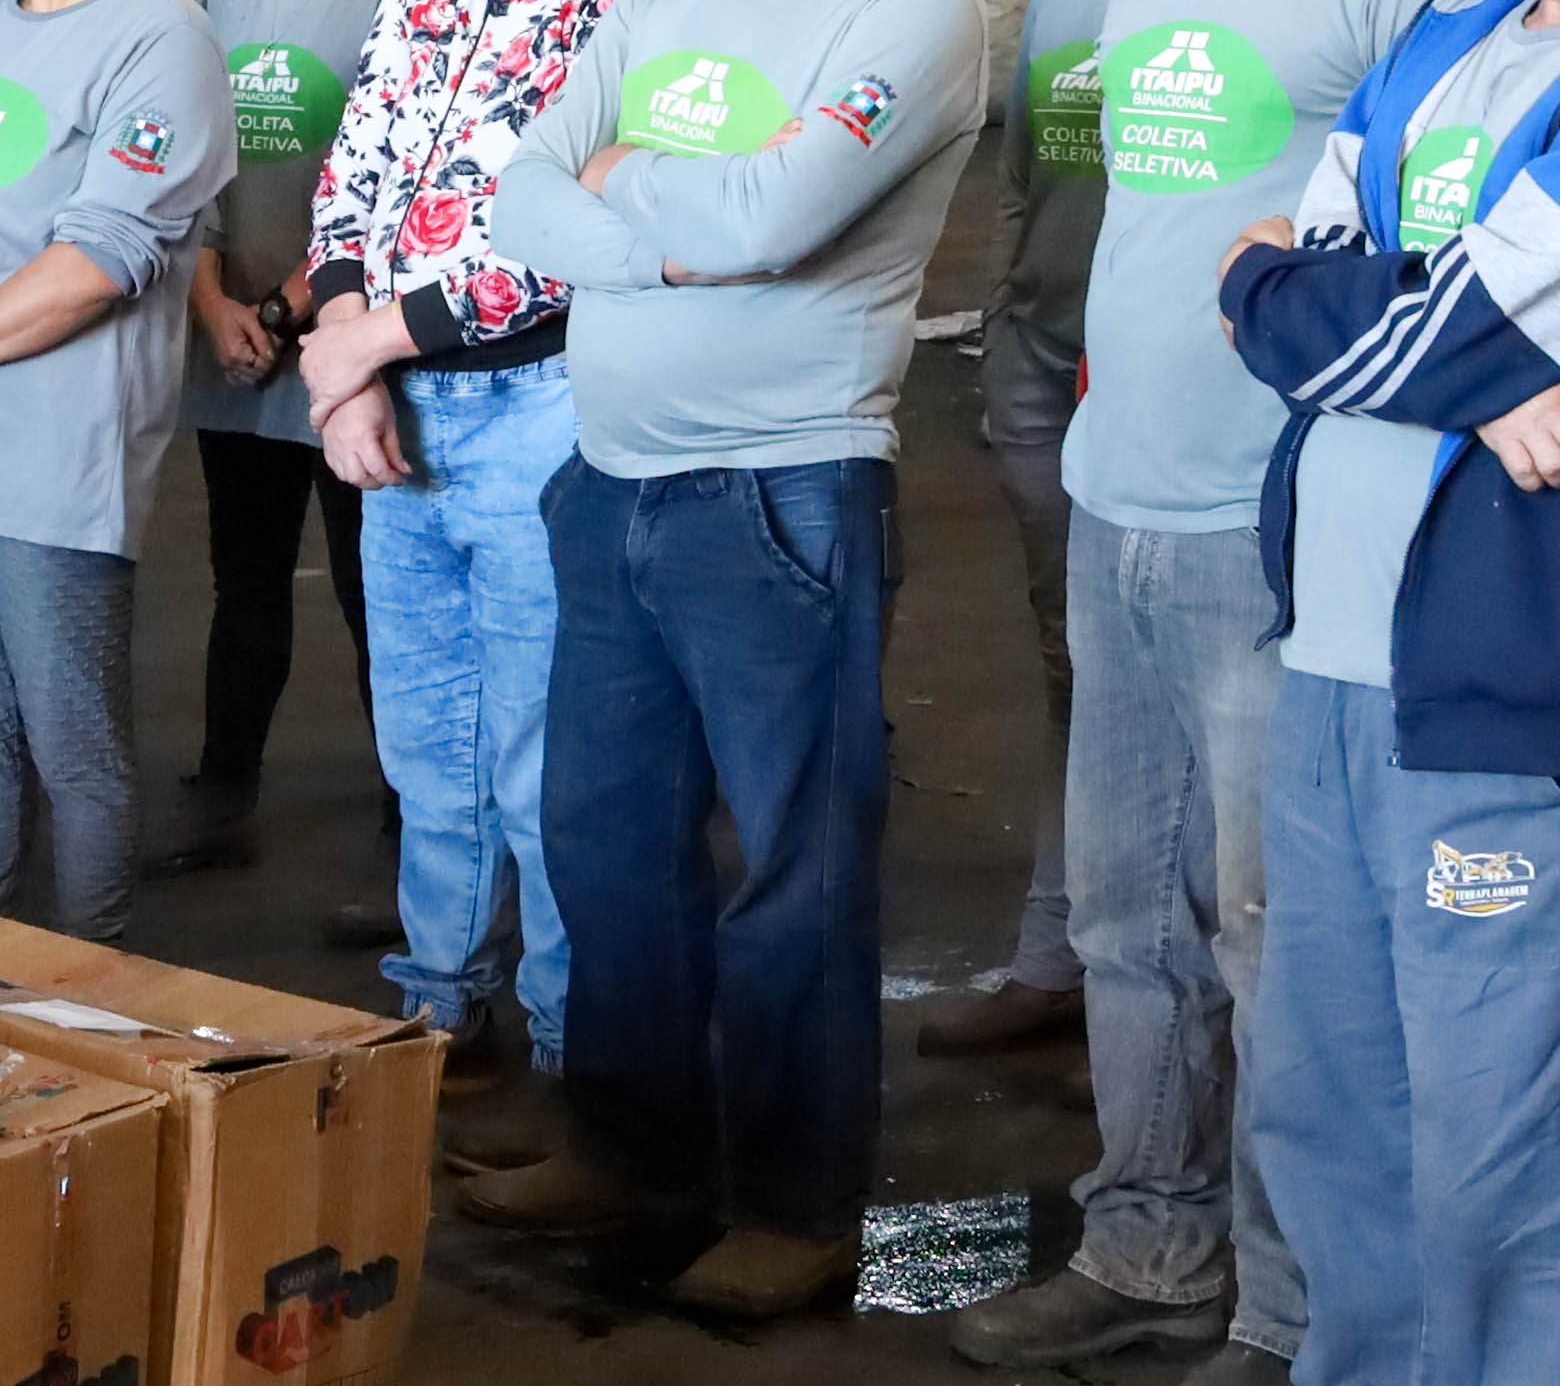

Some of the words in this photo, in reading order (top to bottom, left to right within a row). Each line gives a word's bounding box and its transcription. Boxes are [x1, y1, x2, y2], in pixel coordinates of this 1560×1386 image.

[1129, 67, 1226, 97] ITAIPU
[1132, 92, 1213, 112] BINACIONAL
[1121, 124, 1208, 151] COLETA
[1113, 151, 1219, 182] SELETIVA
